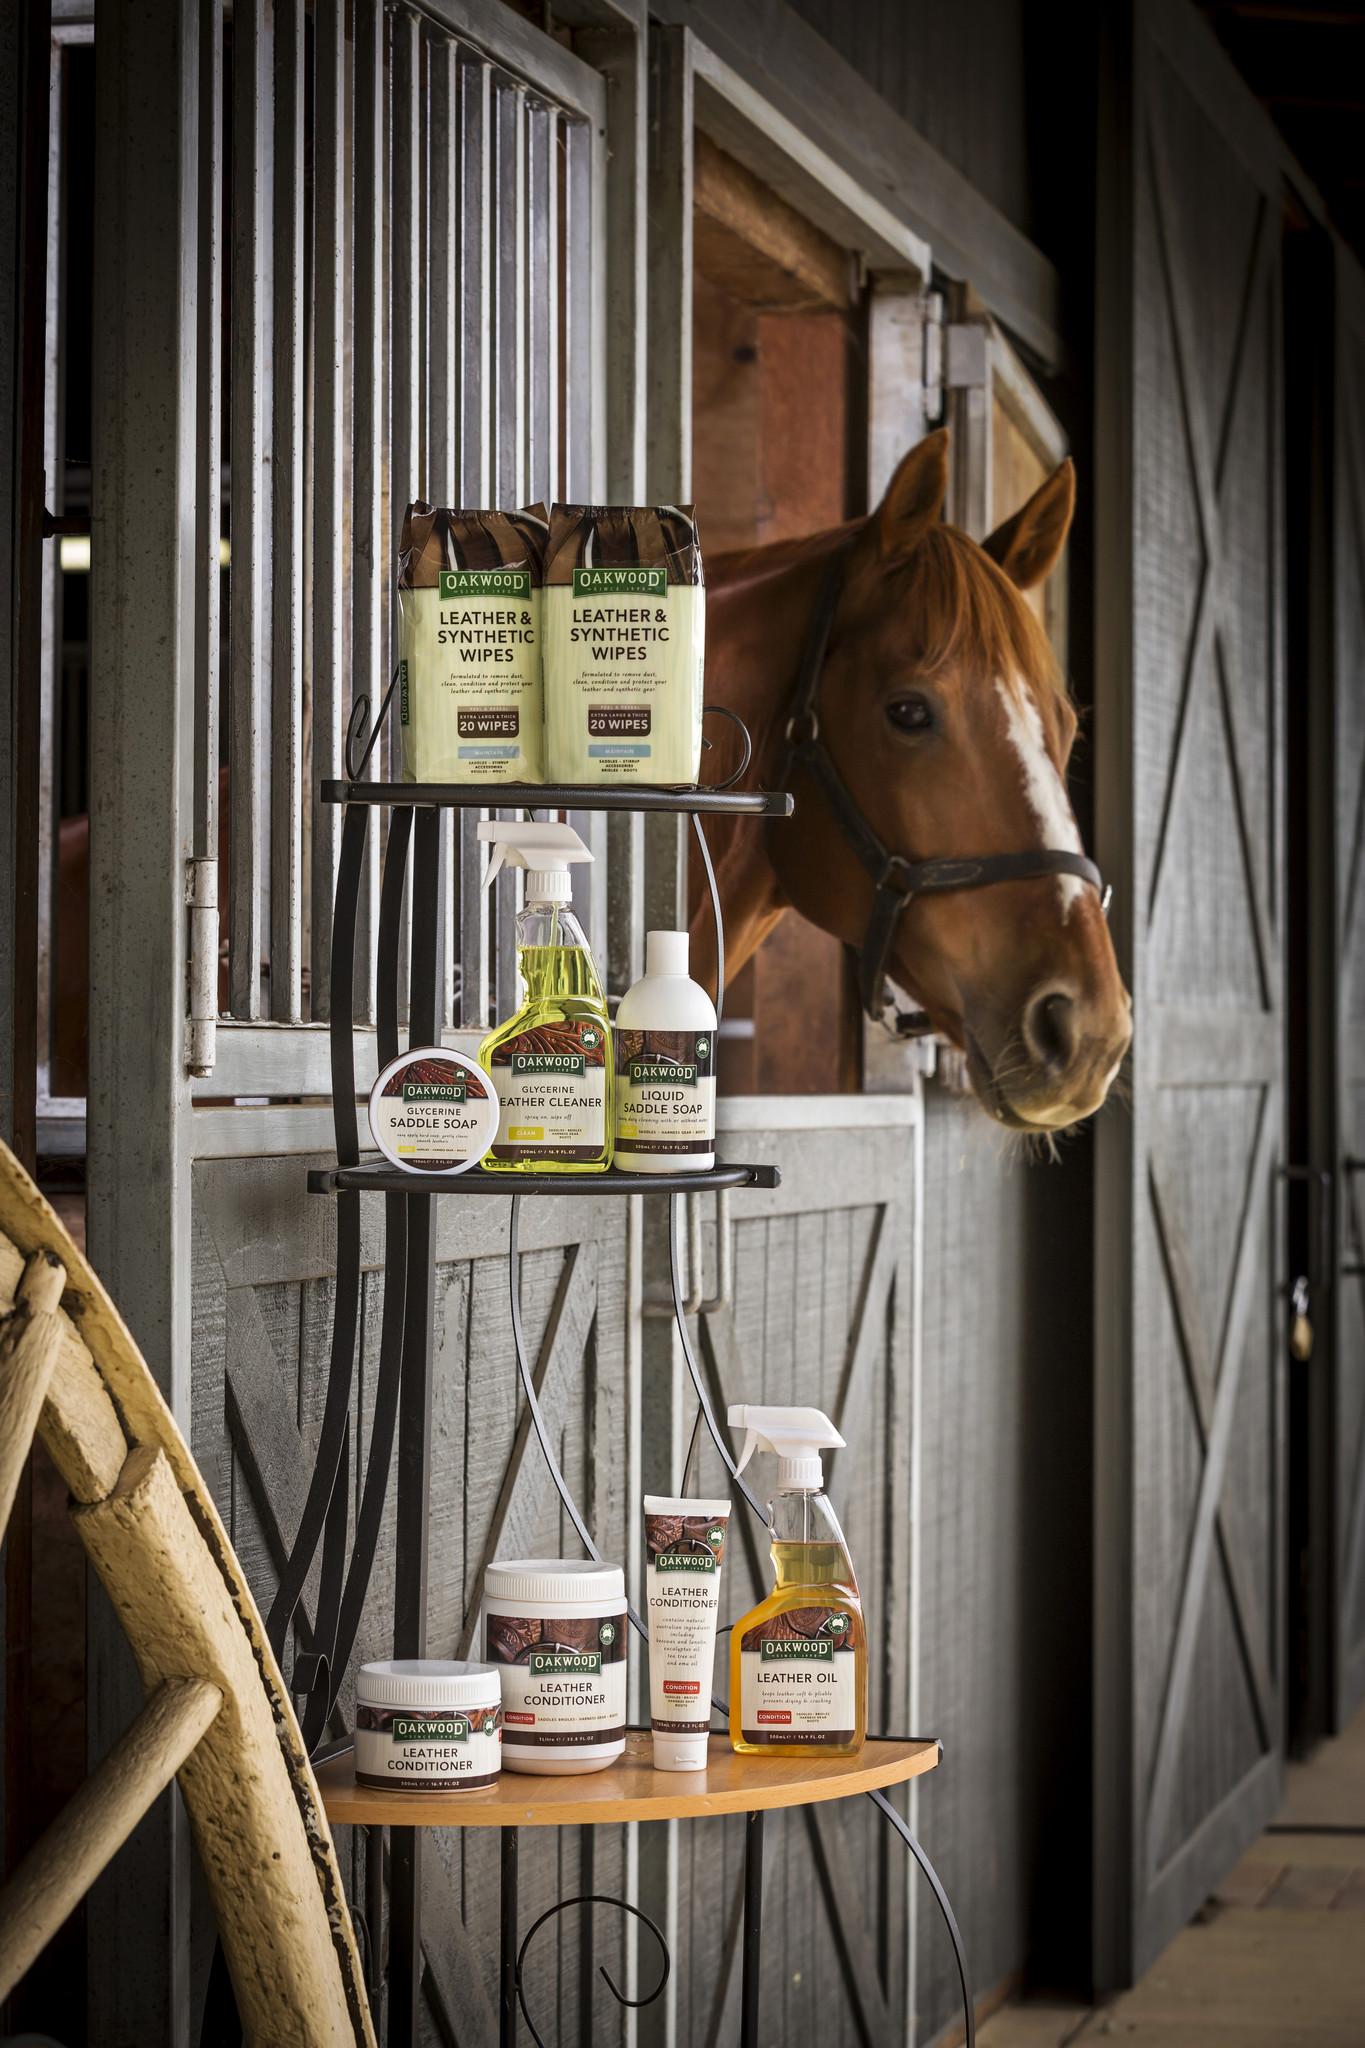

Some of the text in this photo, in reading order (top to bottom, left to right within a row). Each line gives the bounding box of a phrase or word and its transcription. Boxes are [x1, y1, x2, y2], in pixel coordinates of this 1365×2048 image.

[446, 575, 524, 589] OAKWOOD
[580, 572, 660, 586] OAKWOOD
[440, 612, 531, 624] LEATHER &
[573, 609, 667, 622] LEATHER &
[438, 630, 534, 643] SYNTHETIC
[570, 628, 670, 641] SYNTHETIC
[460, 649, 514, 662] WIPES
[592, 647, 647, 660] WIPES
[460, 721, 516, 731] 20 WIPES
[591, 720, 648, 729] 20 WIPES
[518, 1057, 579, 1069] OAKWOOD
[634, 1066, 692, 1079] OAKWOOD
[408, 1086, 461, 1097] OAKWOOD
[642, 1091, 684, 1101] LIQUID
[500, 1098, 602, 1107] EATHER CLEANER
[407, 1107, 461, 1116] GLYCERINE
[624, 1103, 703, 1114] SADDLE SOAP
[390, 1118, 478, 1129] SADDLE SOAP
[660, 1556, 713, 1568] OAKWOOD
[662, 1588, 708, 1596] LEATHER
[650, 1598, 717, 1608] CONDITIONER
[766, 1642, 828, 1654] OAKWOOD
[535, 1656, 597, 1668] OAKWOOD
[757, 1673, 838, 1683] LEATHER OIL
[540, 1683, 593, 1693] LEATHER
[524, 1694, 605, 1705] CONDITIONER
[398, 1722, 463, 1735] OAKWOOD
[403, 1748, 458, 1758] LEATHER
[388, 1760, 472, 1771] CONDITIONER
